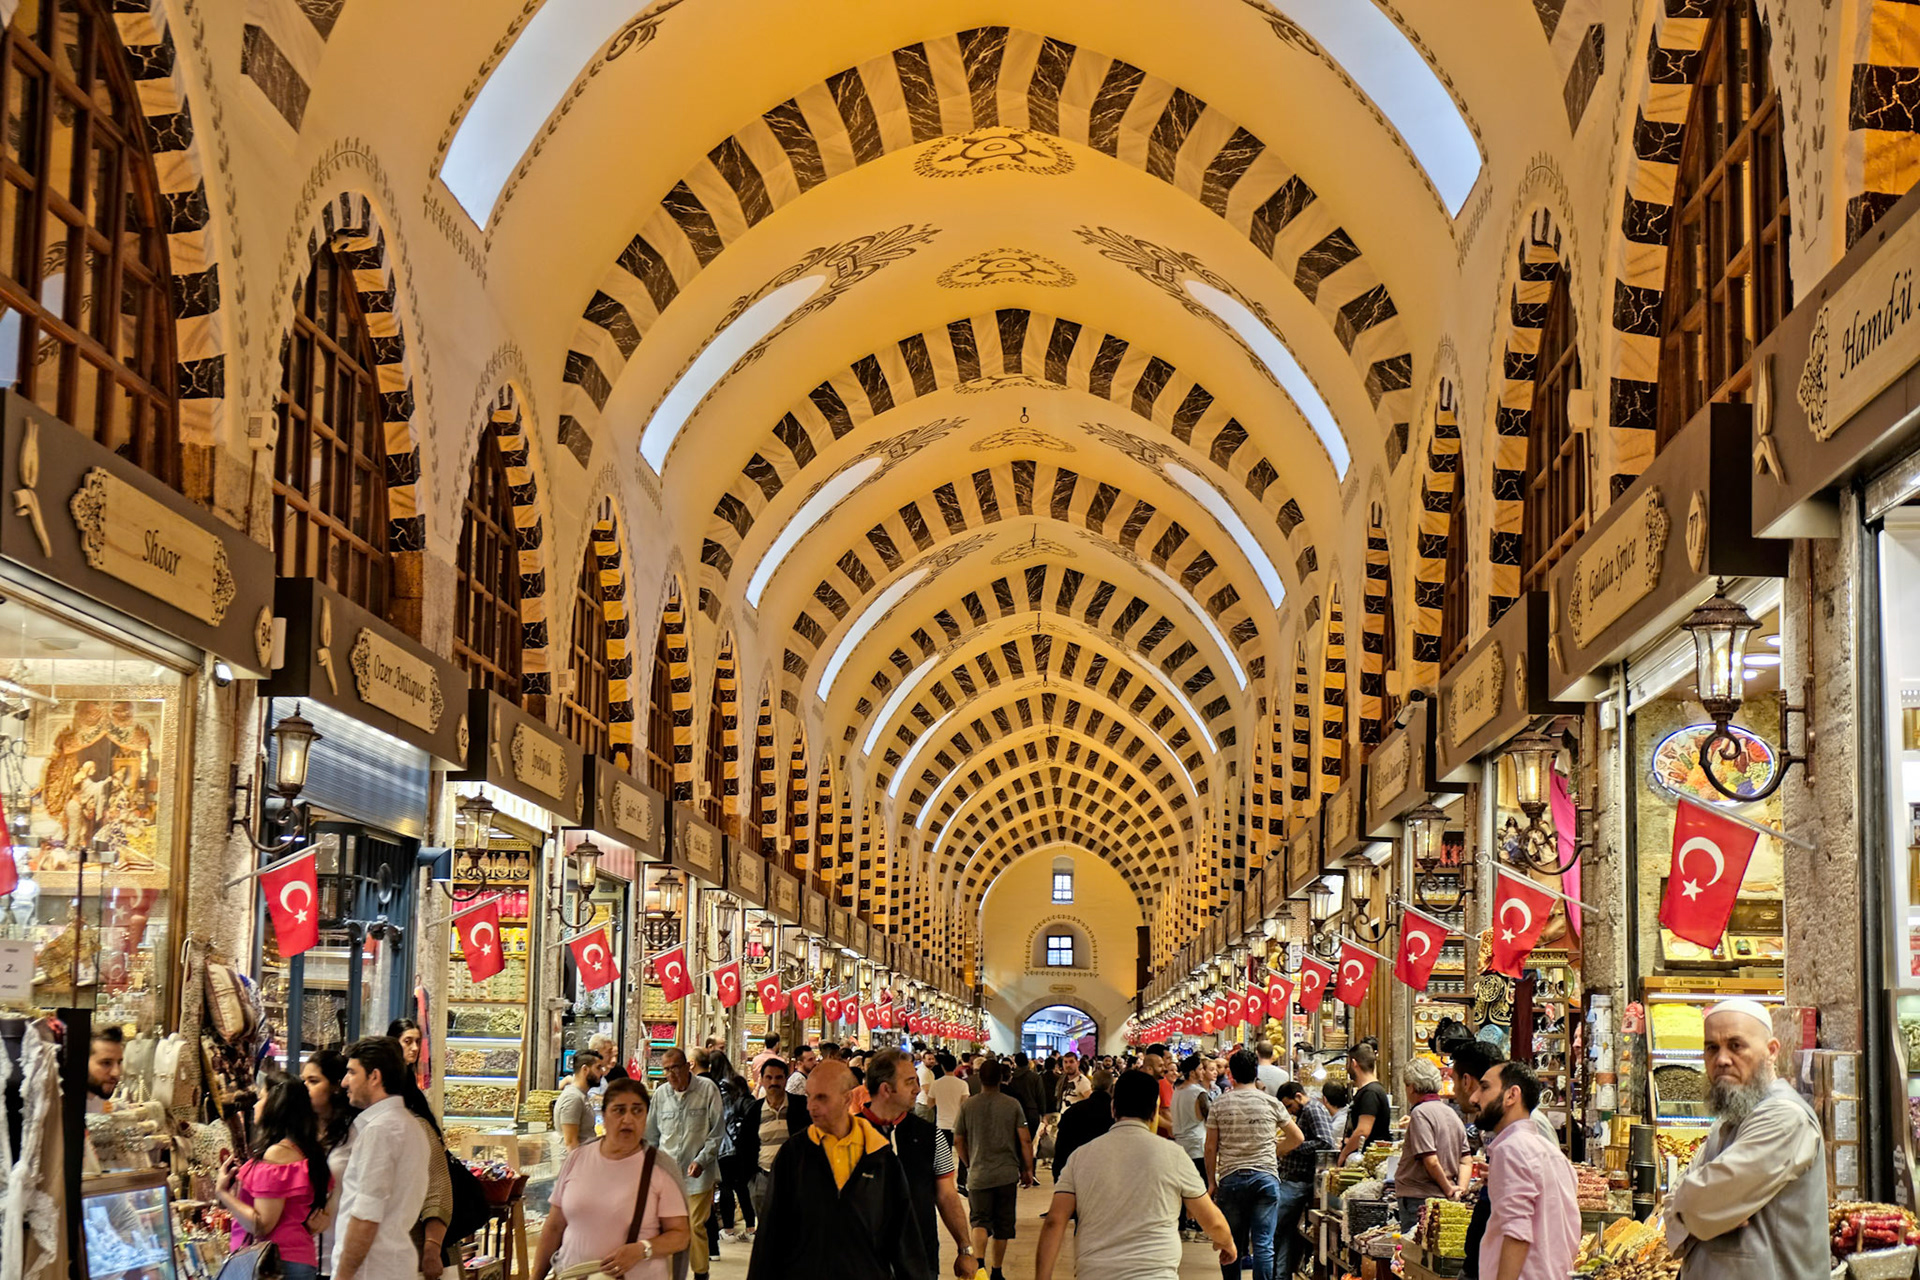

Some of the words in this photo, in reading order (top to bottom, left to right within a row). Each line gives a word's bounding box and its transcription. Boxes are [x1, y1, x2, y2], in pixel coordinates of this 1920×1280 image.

[1840, 267, 1913, 379] Hamd-ü
[142, 529, 180, 576] Shoar
[1689, 511, 1699, 551] 77
[1589, 556, 1614, 612] Galata
[1615, 535, 1636, 592] Spice
[261, 622, 271, 650] 84
[394, 666, 427, 707] Antiques
